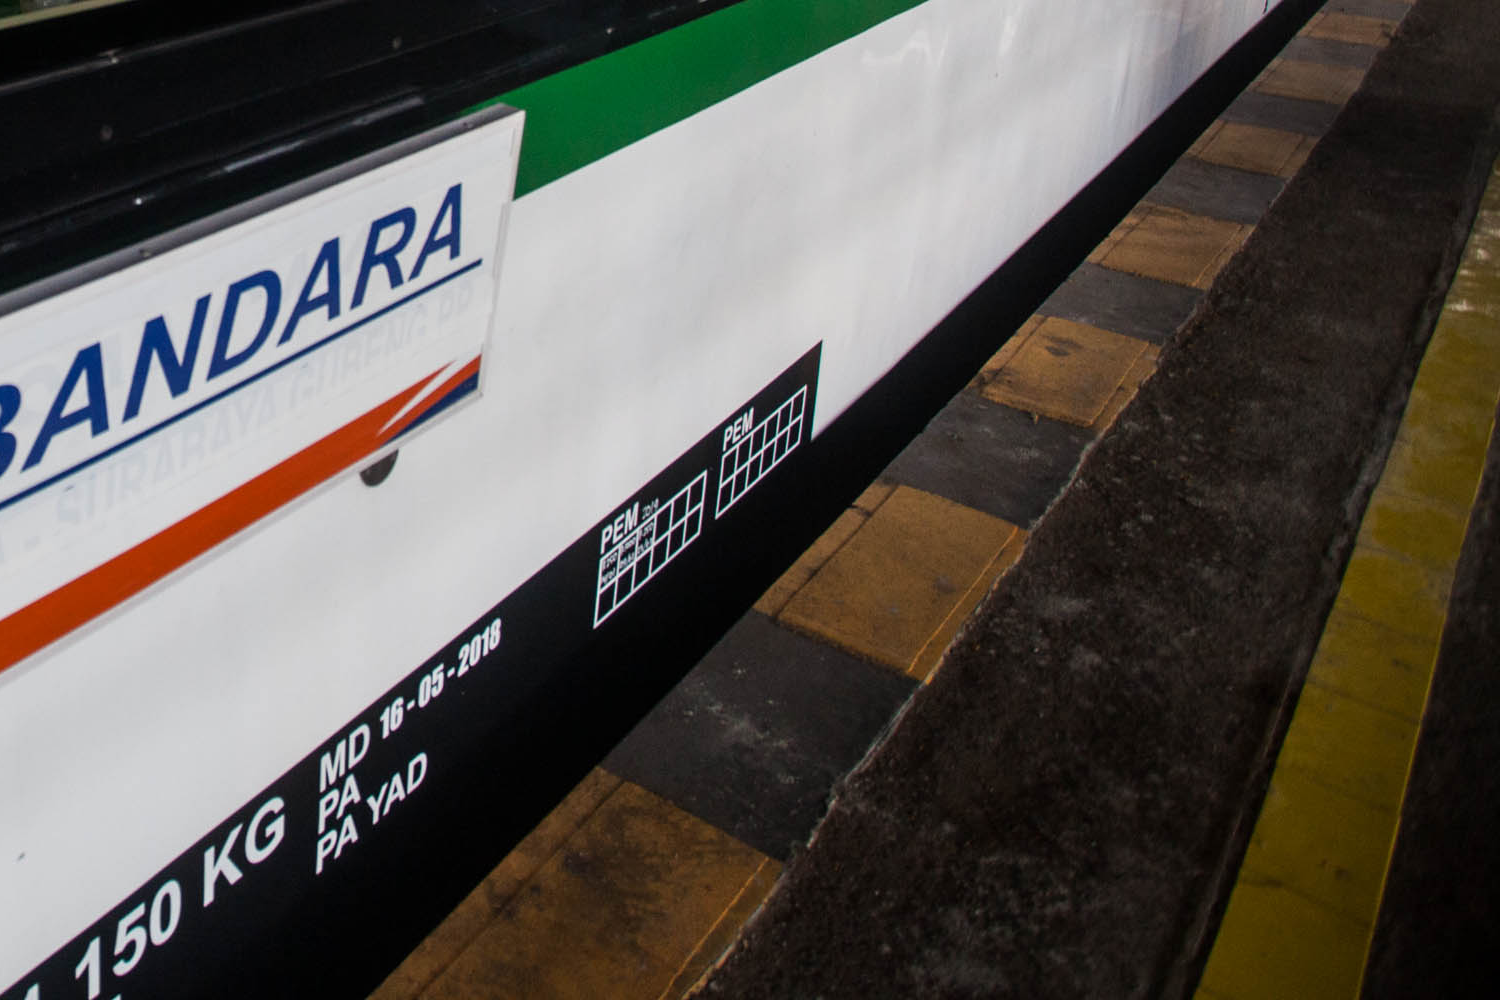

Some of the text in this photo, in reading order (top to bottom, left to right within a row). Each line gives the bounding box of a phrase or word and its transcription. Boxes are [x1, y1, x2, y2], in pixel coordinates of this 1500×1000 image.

[723, 408, 754, 451] PEM
[601, 502, 639, 554] PEM
[320, 724, 370, 792] MD
[316, 753, 427, 874] PA YAD
[318, 773, 360, 834] PA
[76, 797, 284, 1000] 150 KG
